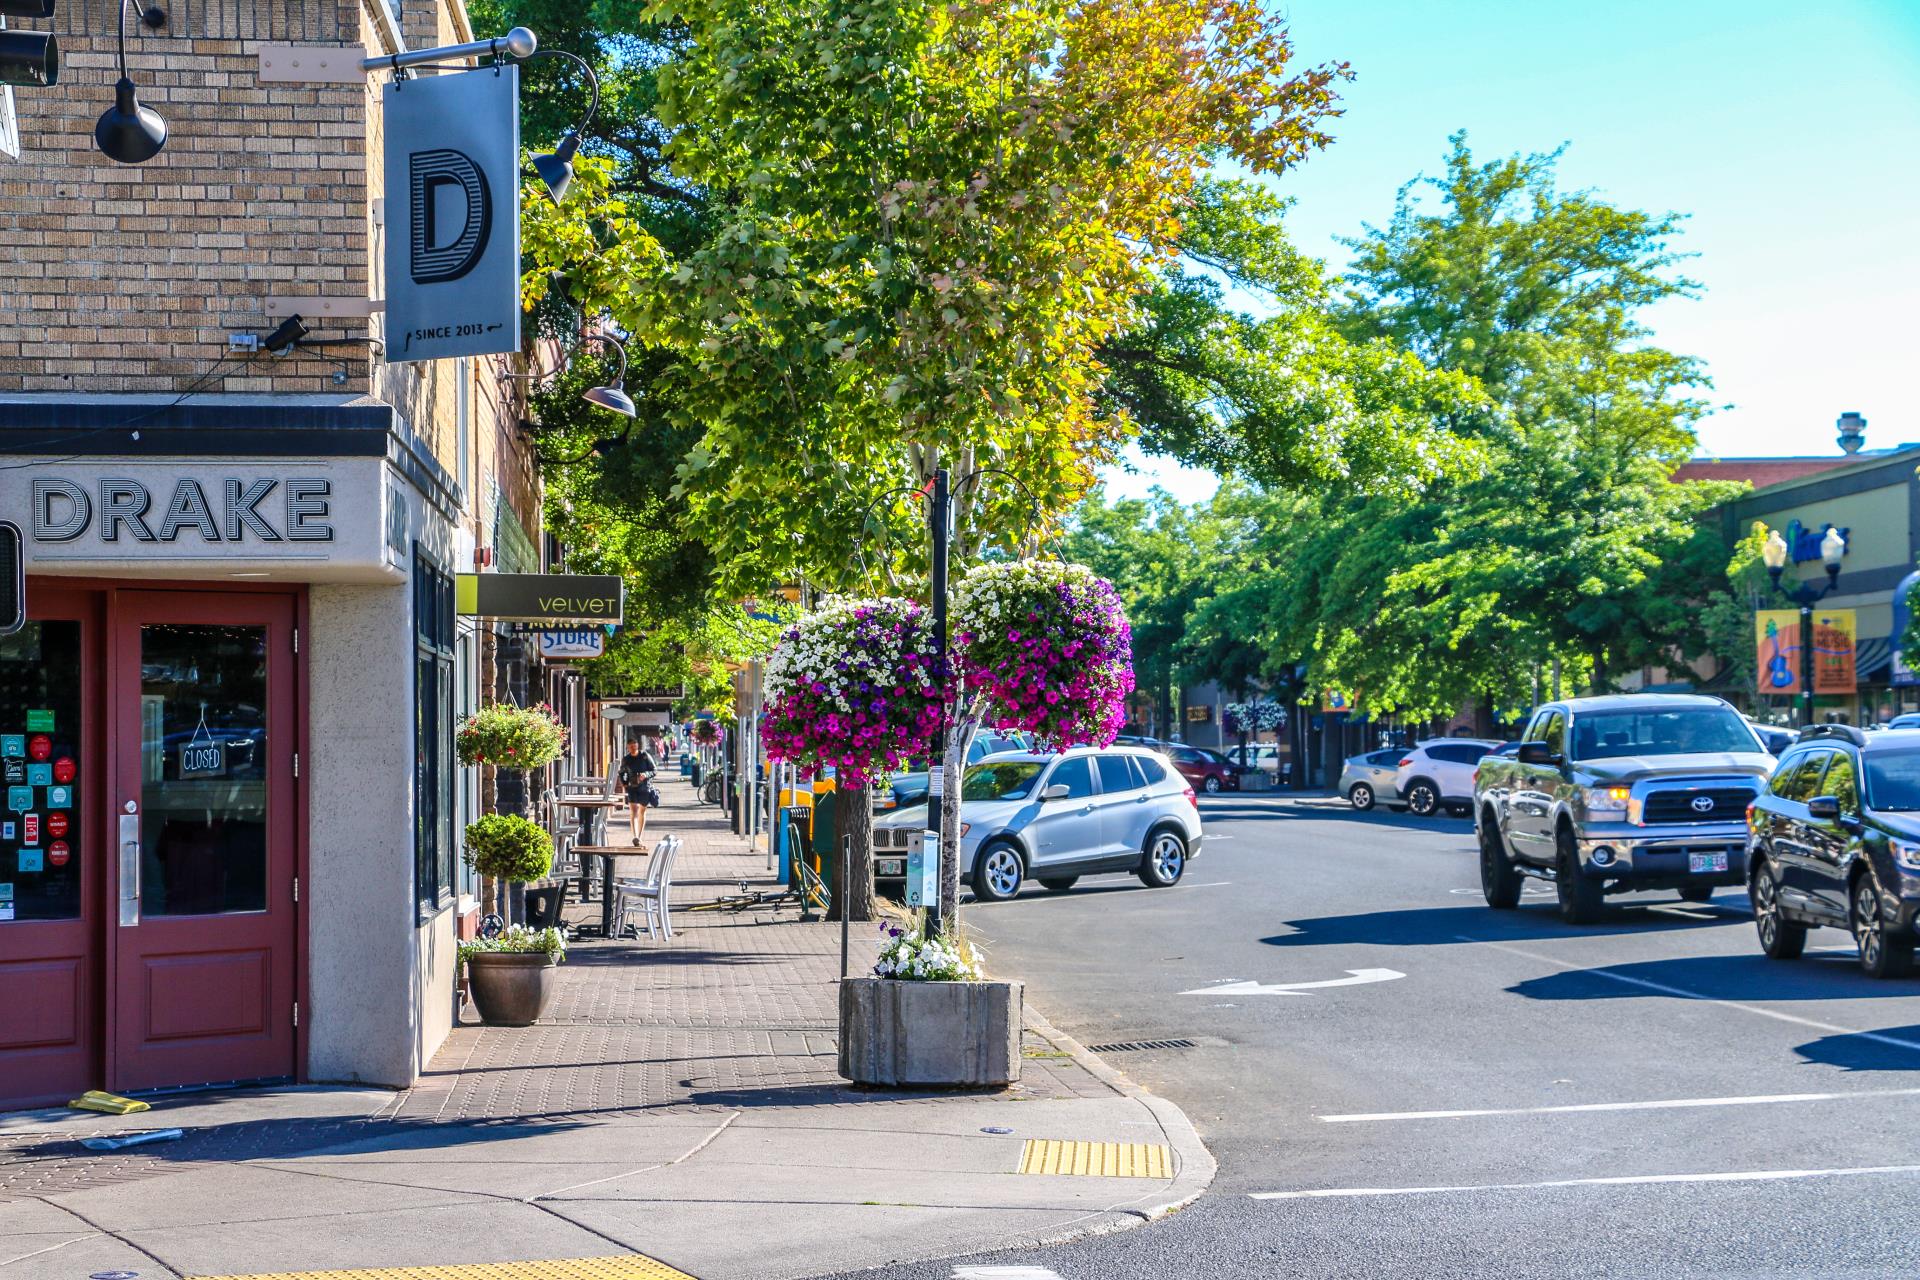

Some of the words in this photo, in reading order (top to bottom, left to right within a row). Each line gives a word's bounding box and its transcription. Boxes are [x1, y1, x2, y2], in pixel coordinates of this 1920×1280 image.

[409, 149, 493, 285] D
[415, 326, 451, 340] SINCE
[456, 323, 483, 336] 2013
[32, 478, 334, 543] DRAKE
[543, 630, 600, 650] STORE
[183, 748, 220, 770] CLOSED
